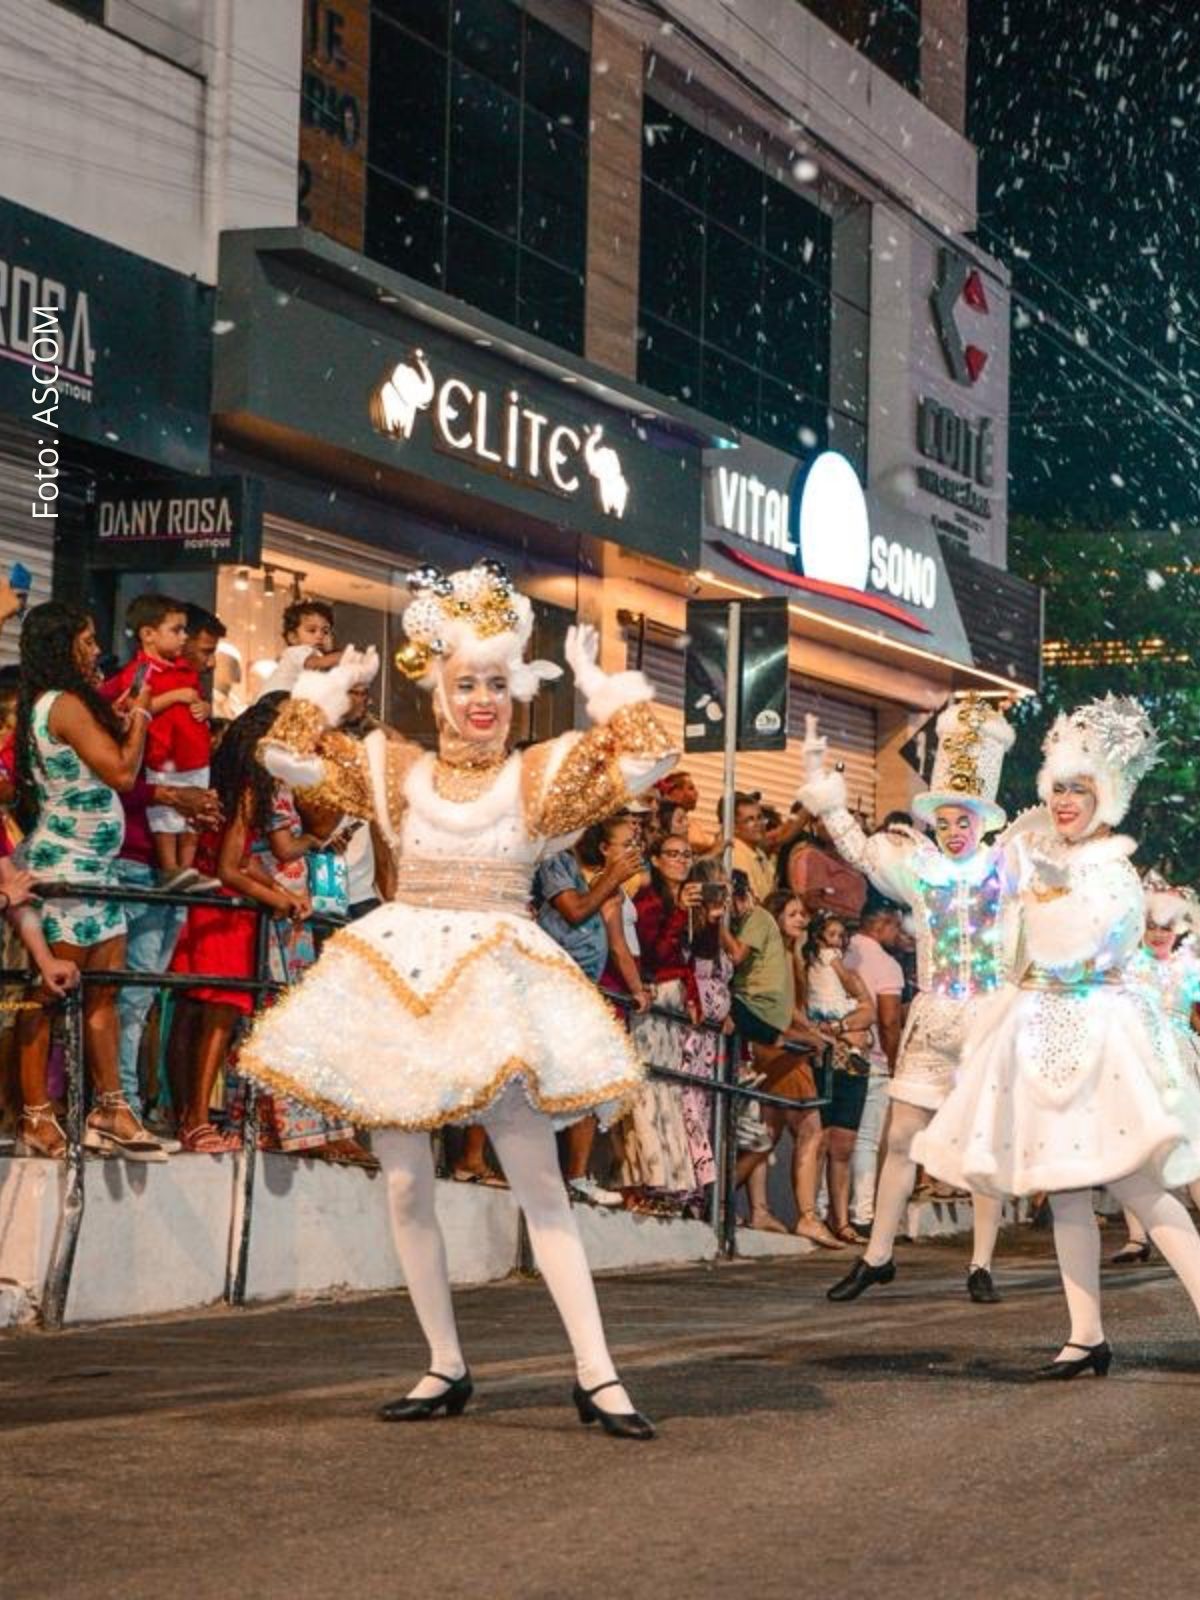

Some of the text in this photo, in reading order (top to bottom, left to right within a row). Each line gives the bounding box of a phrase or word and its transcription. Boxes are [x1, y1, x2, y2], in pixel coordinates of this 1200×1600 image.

[99, 497, 233, 537] DANY ROSA
[718, 466, 937, 610] VITAL SONO
